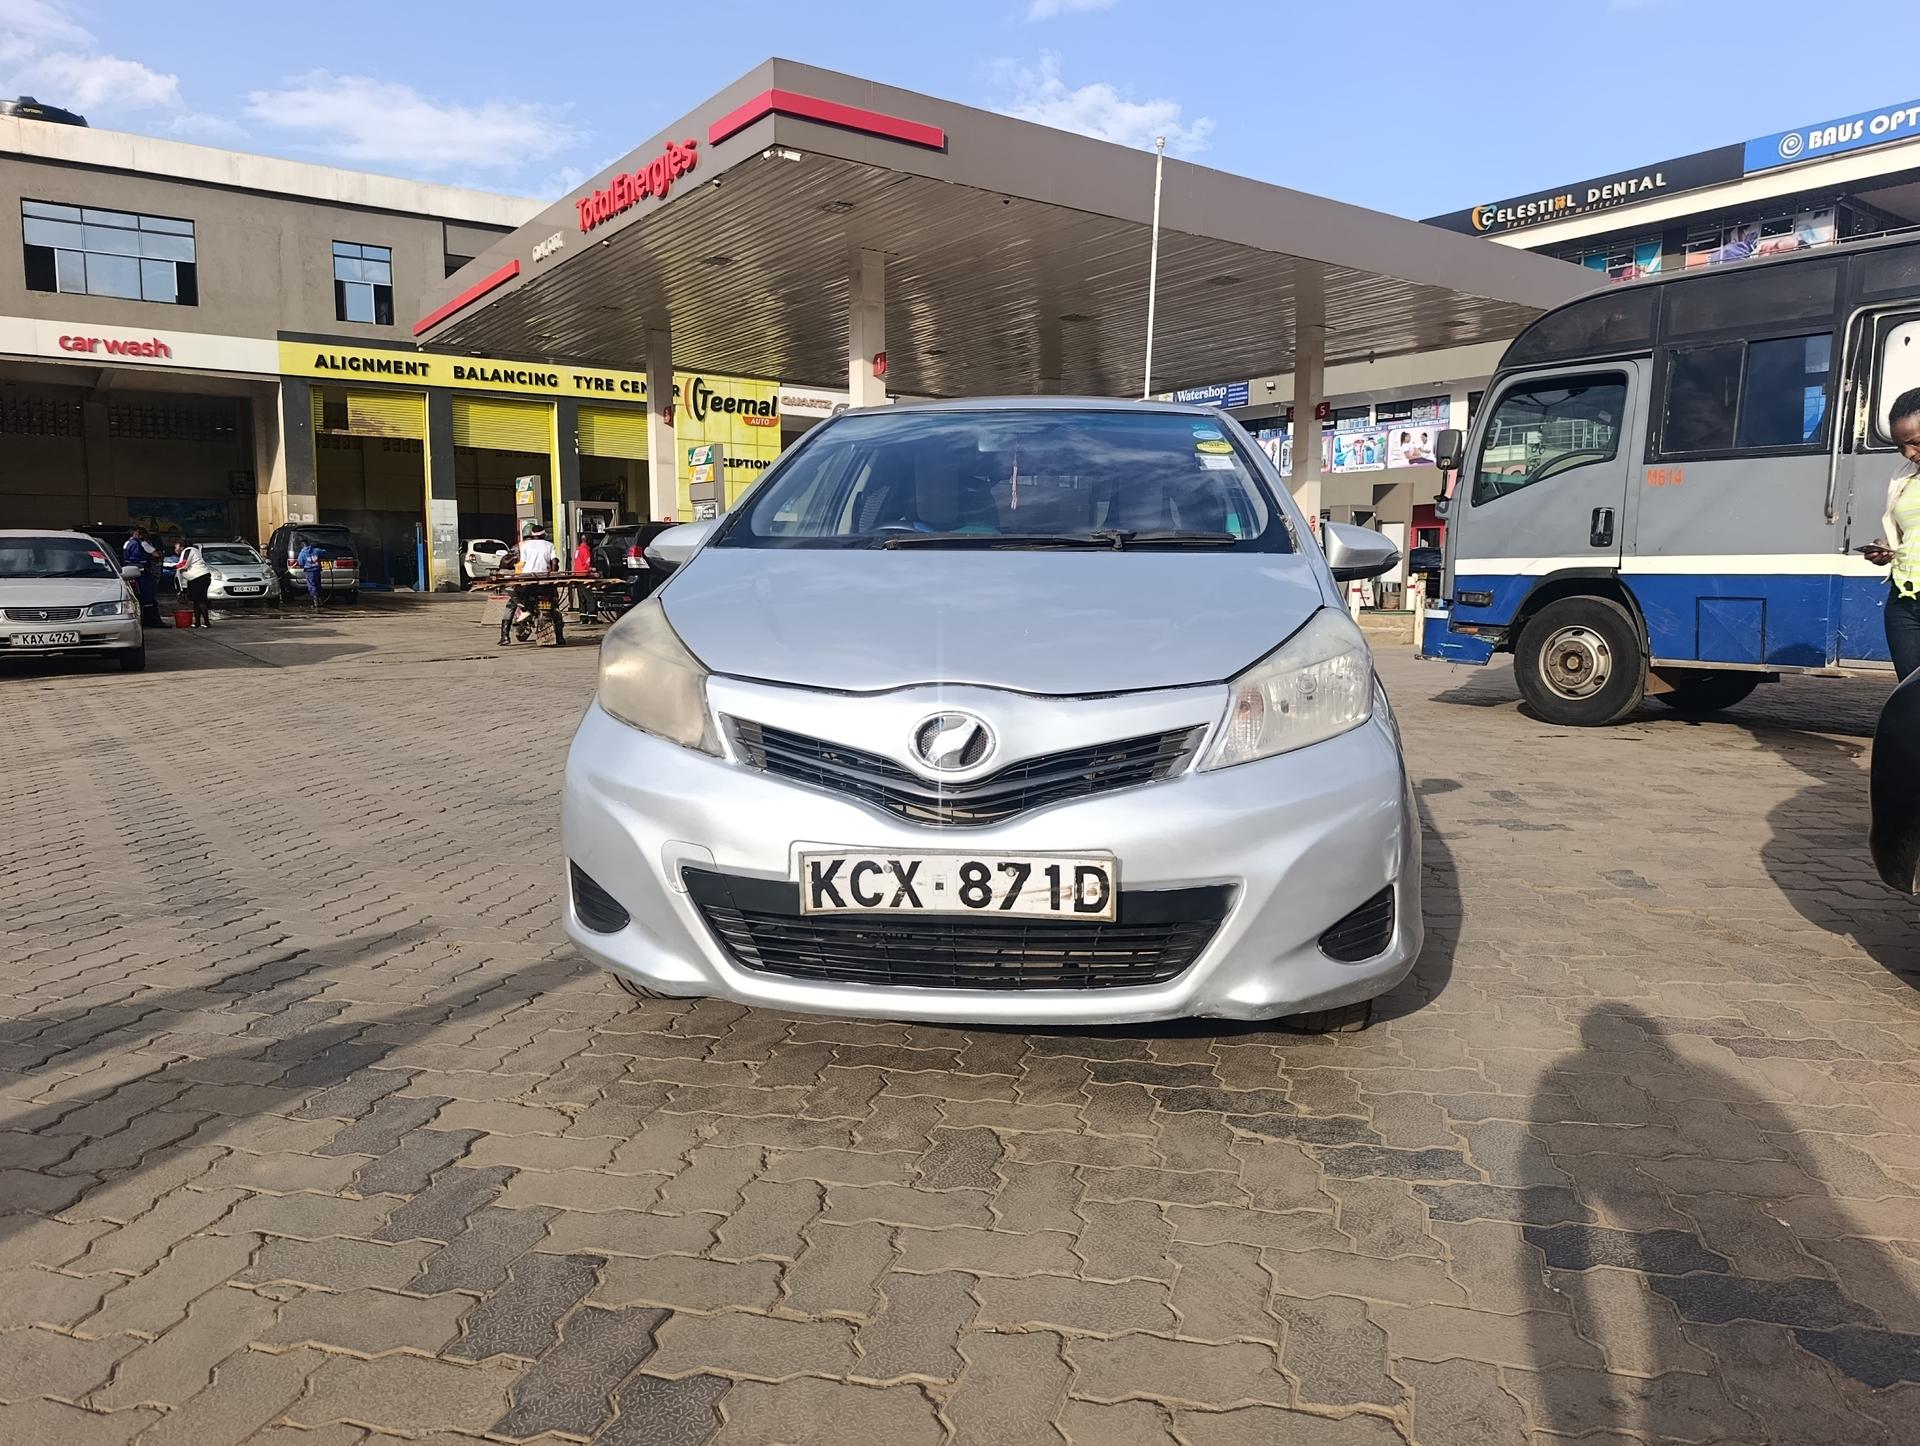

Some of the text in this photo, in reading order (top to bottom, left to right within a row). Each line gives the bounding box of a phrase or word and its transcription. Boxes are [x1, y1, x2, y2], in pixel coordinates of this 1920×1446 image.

[1808, 106, 1920, 150] BAUS OPT
[576, 138, 698, 234] TotalEnergies
[1588, 173, 1667, 203] DENTAL
[58, 335, 172, 359] car wash
[314, 354, 430, 377] ALIGNMENT
[453, 365, 559, 388] BALANCING
[573, 375, 615, 393] TYRE
[698, 386, 778, 418] Teemal
[1177, 385, 1227, 402] Watershop
[750, 416, 770, 425] AUTO
[1320, 404, 1326, 416] 5
[724, 457, 771, 470] CEPTION
[22, 634, 45, 645] KAX
[811, 859, 1110, 914] KCX 871D
